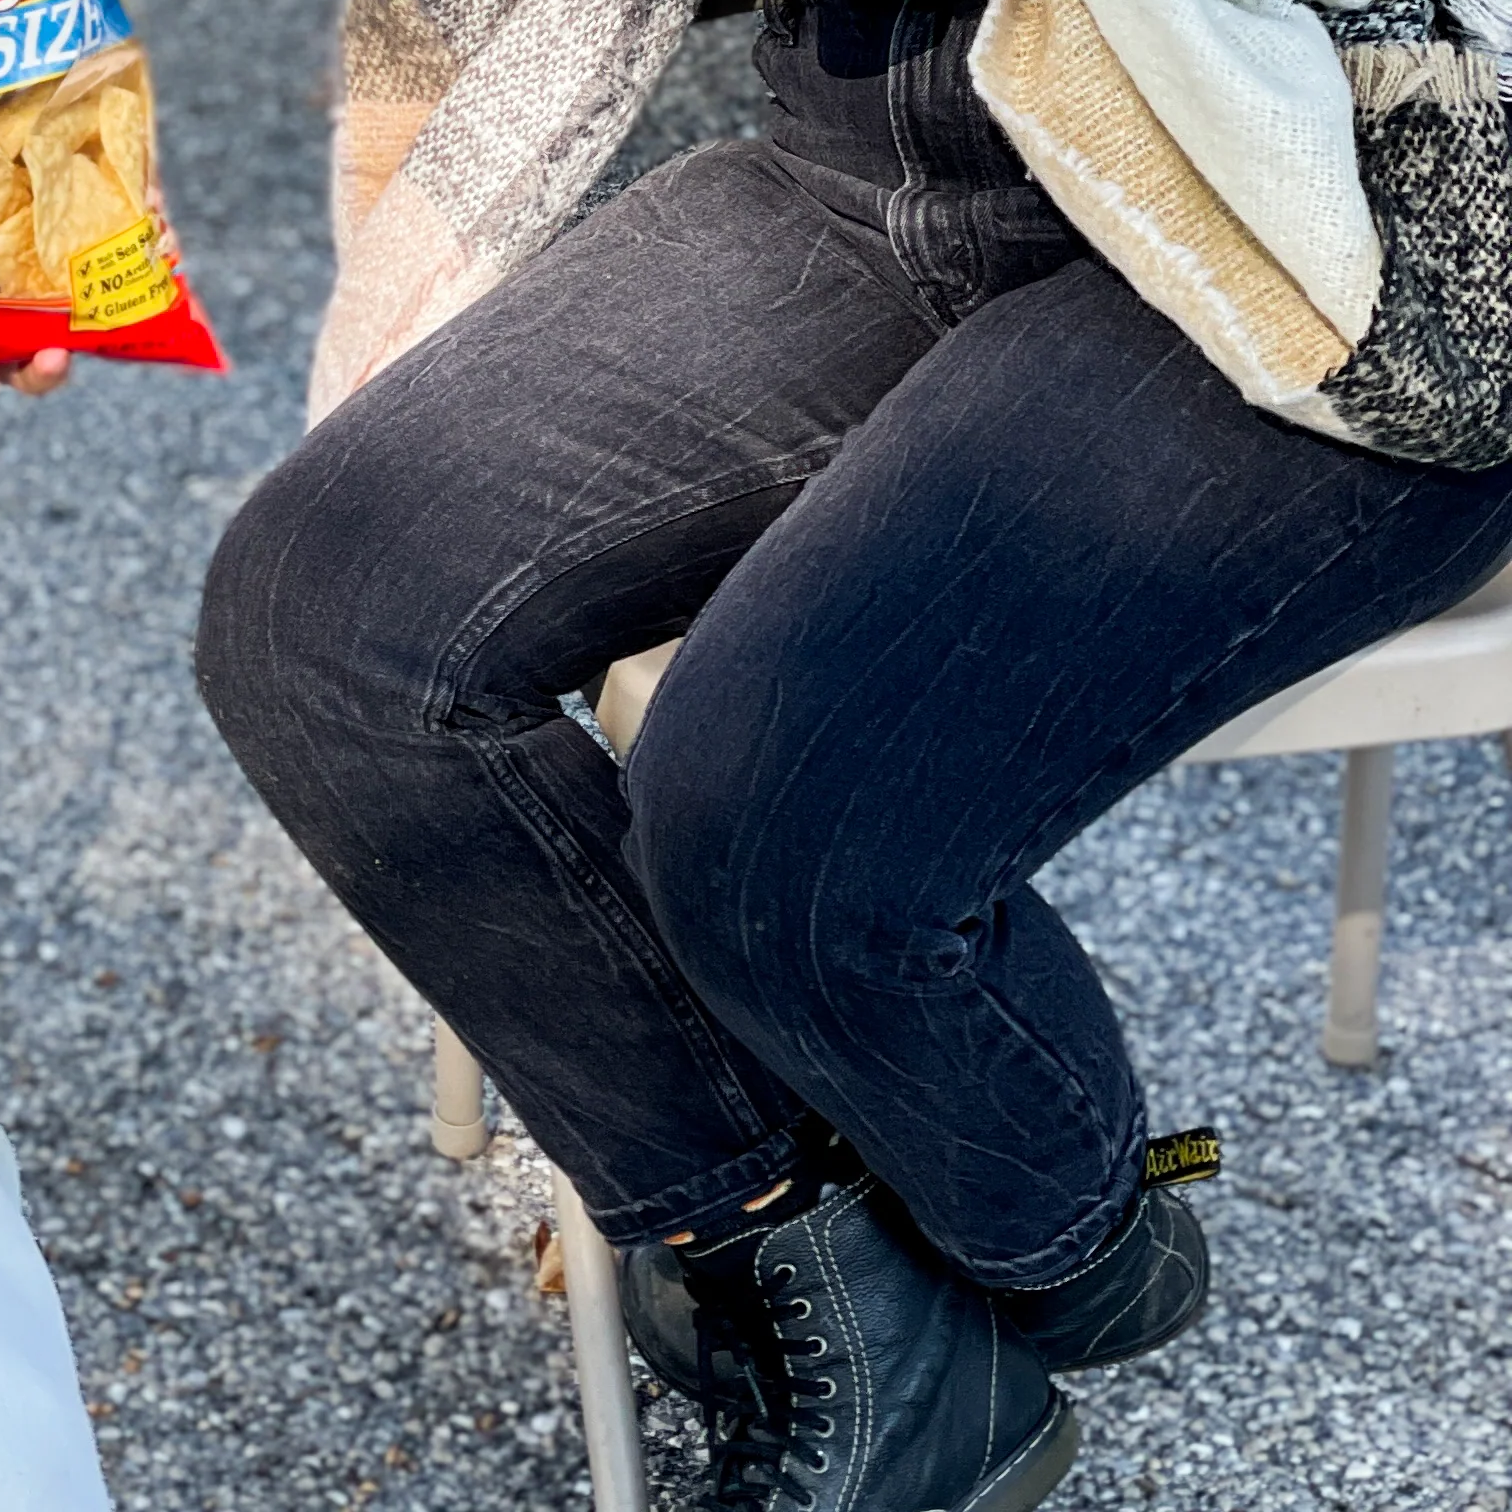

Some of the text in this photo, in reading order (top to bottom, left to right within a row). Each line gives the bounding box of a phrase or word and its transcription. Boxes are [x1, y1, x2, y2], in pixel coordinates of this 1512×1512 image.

[115, 244, 138, 260] Sea
[138, 226, 155, 248] Sal
[100, 274, 123, 295] NO
[104, 293, 146, 317] Gluten
